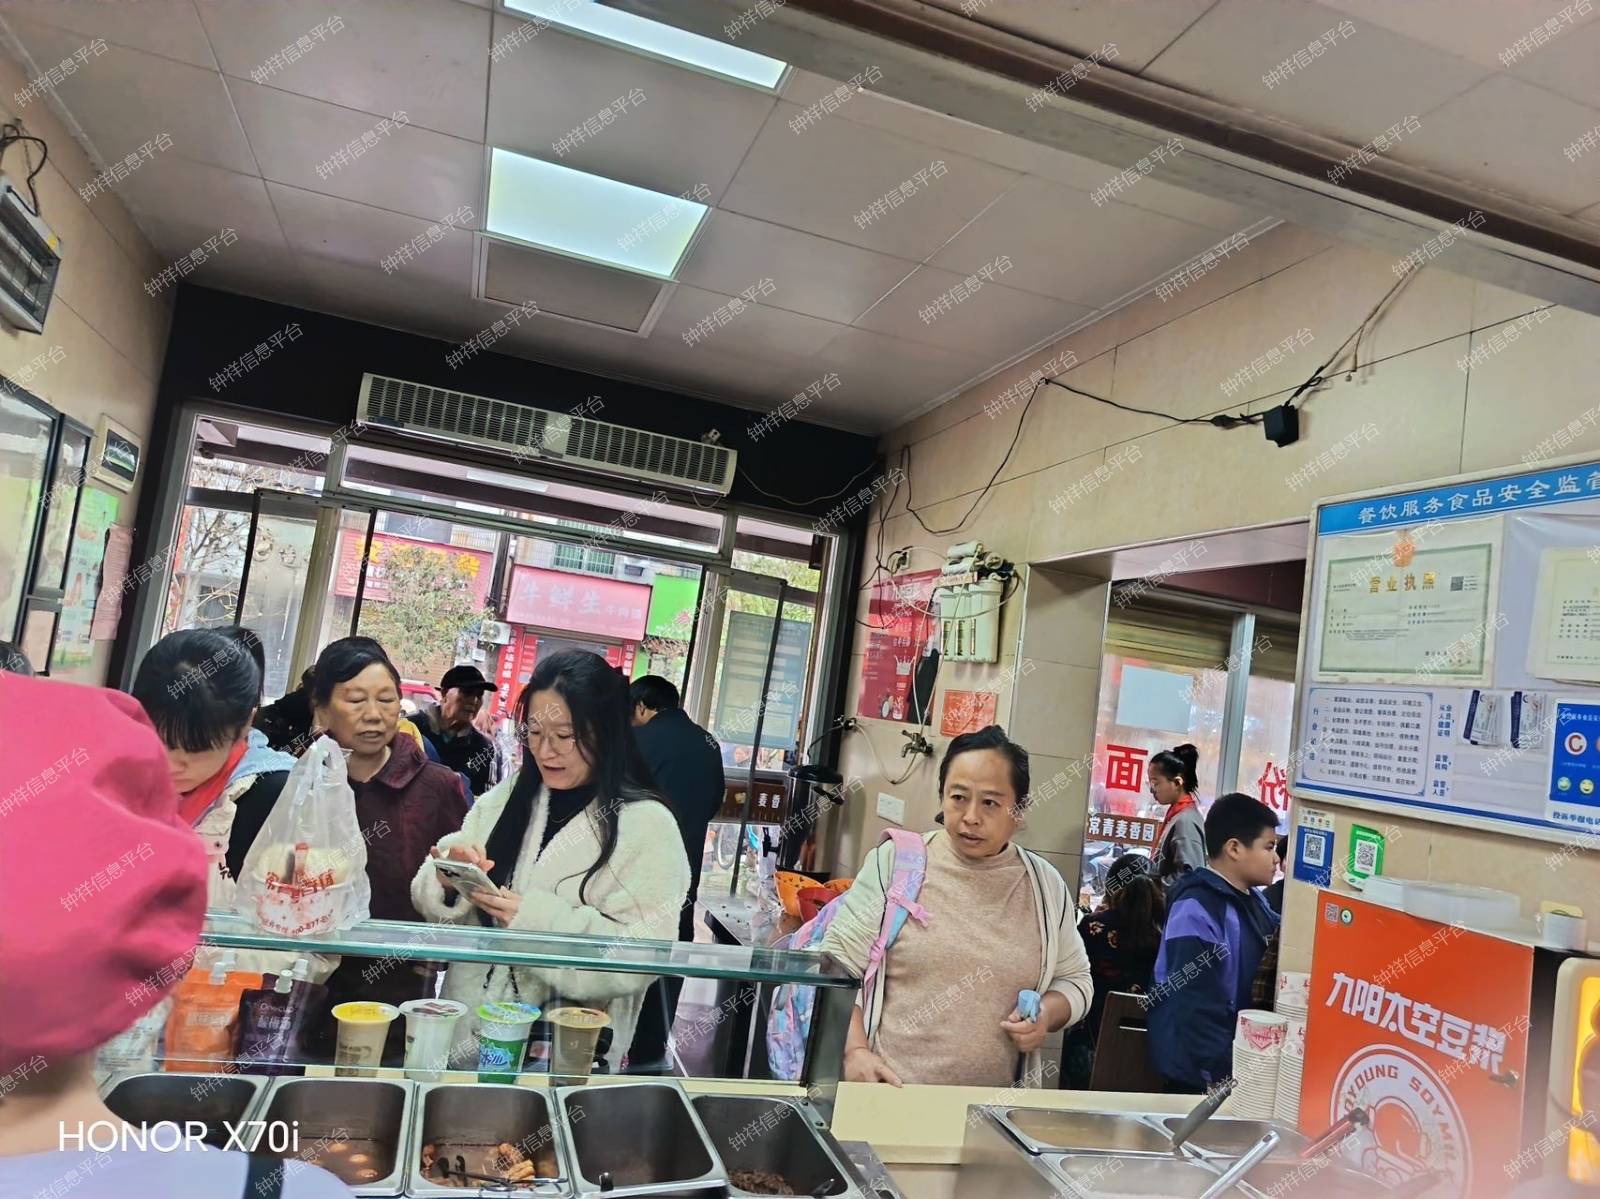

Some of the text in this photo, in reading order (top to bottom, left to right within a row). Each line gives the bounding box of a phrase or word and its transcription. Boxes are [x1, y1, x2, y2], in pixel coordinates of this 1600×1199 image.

[1105, 743, 1148, 793] 面
[1088, 816, 1154, 841] 常青麦香园
[1325, 971, 1507, 1075] 九阳太空豆浆
